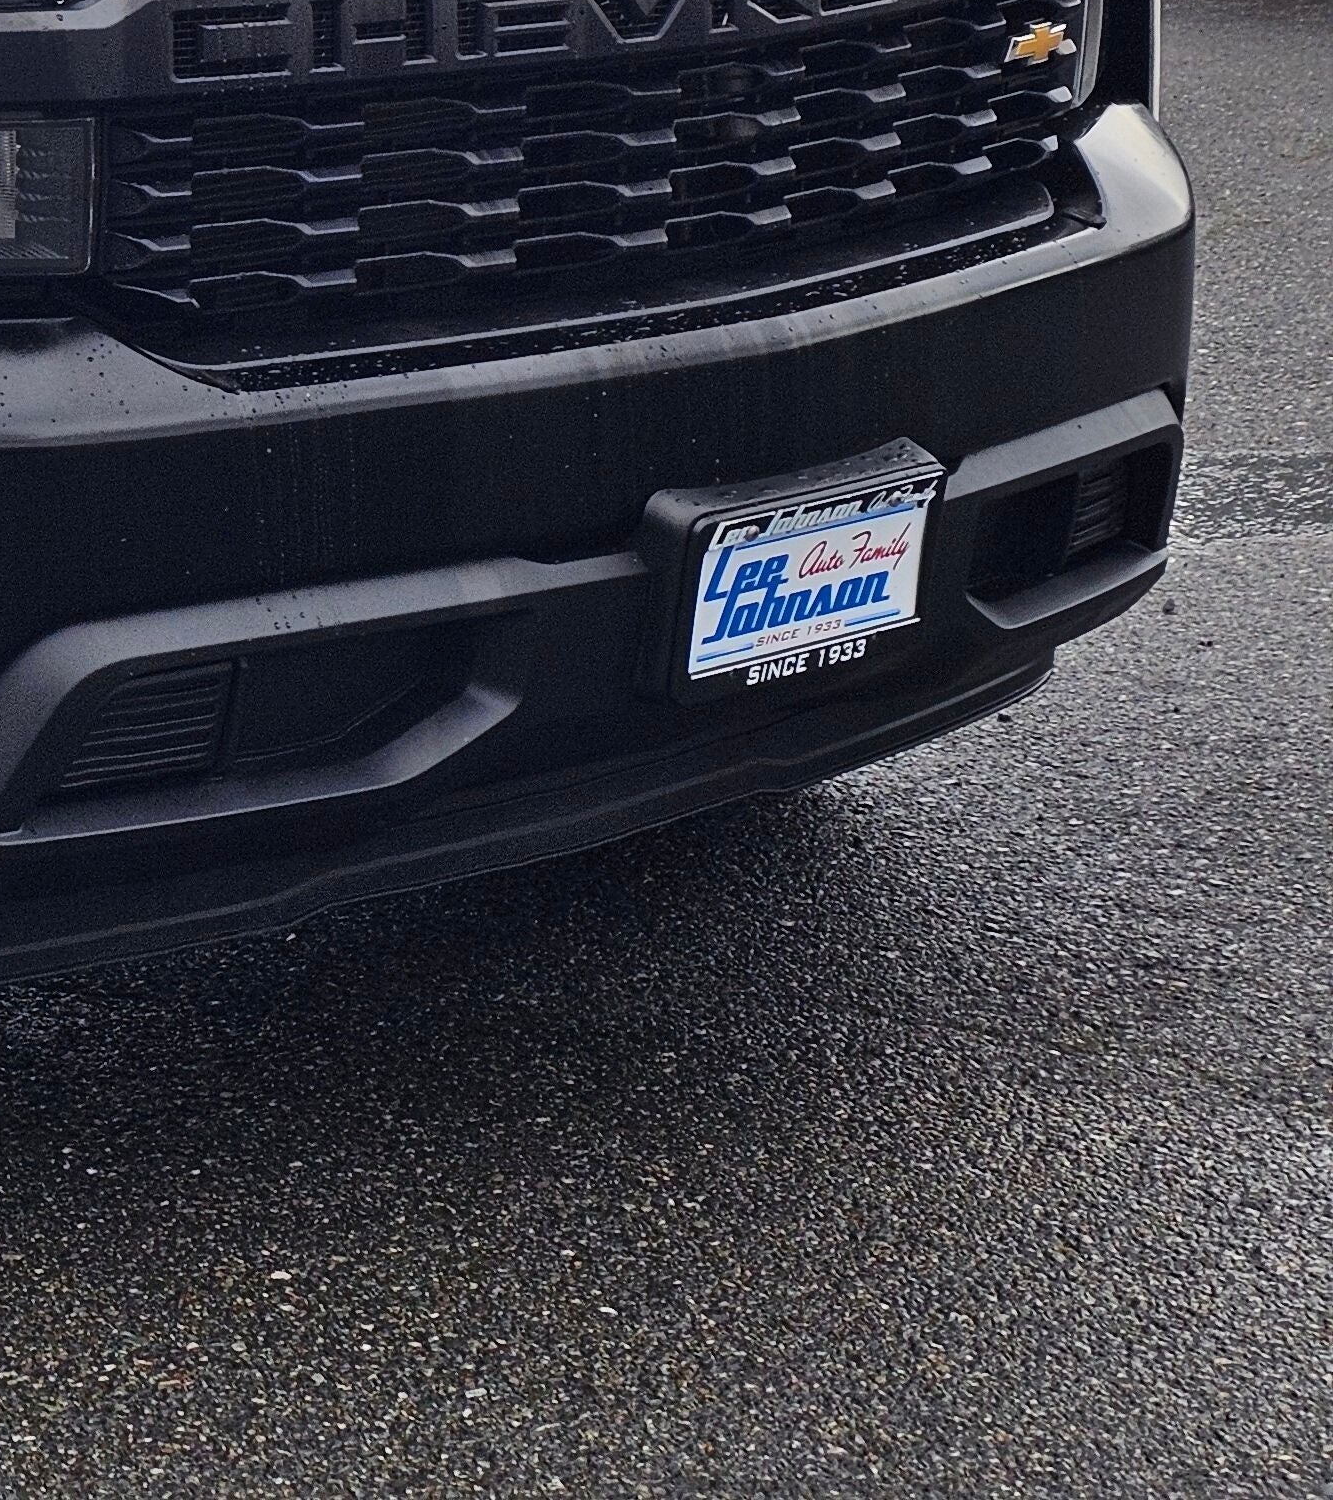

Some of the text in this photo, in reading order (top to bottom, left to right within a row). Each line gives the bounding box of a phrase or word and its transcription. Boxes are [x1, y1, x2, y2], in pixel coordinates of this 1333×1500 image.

[704, 522, 911, 603] Lee Auto Family
[701, 570, 891, 645] Johnson
[755, 619, 843, 647] SINCE 1933
[746, 639, 868, 686] SINCE 1933
